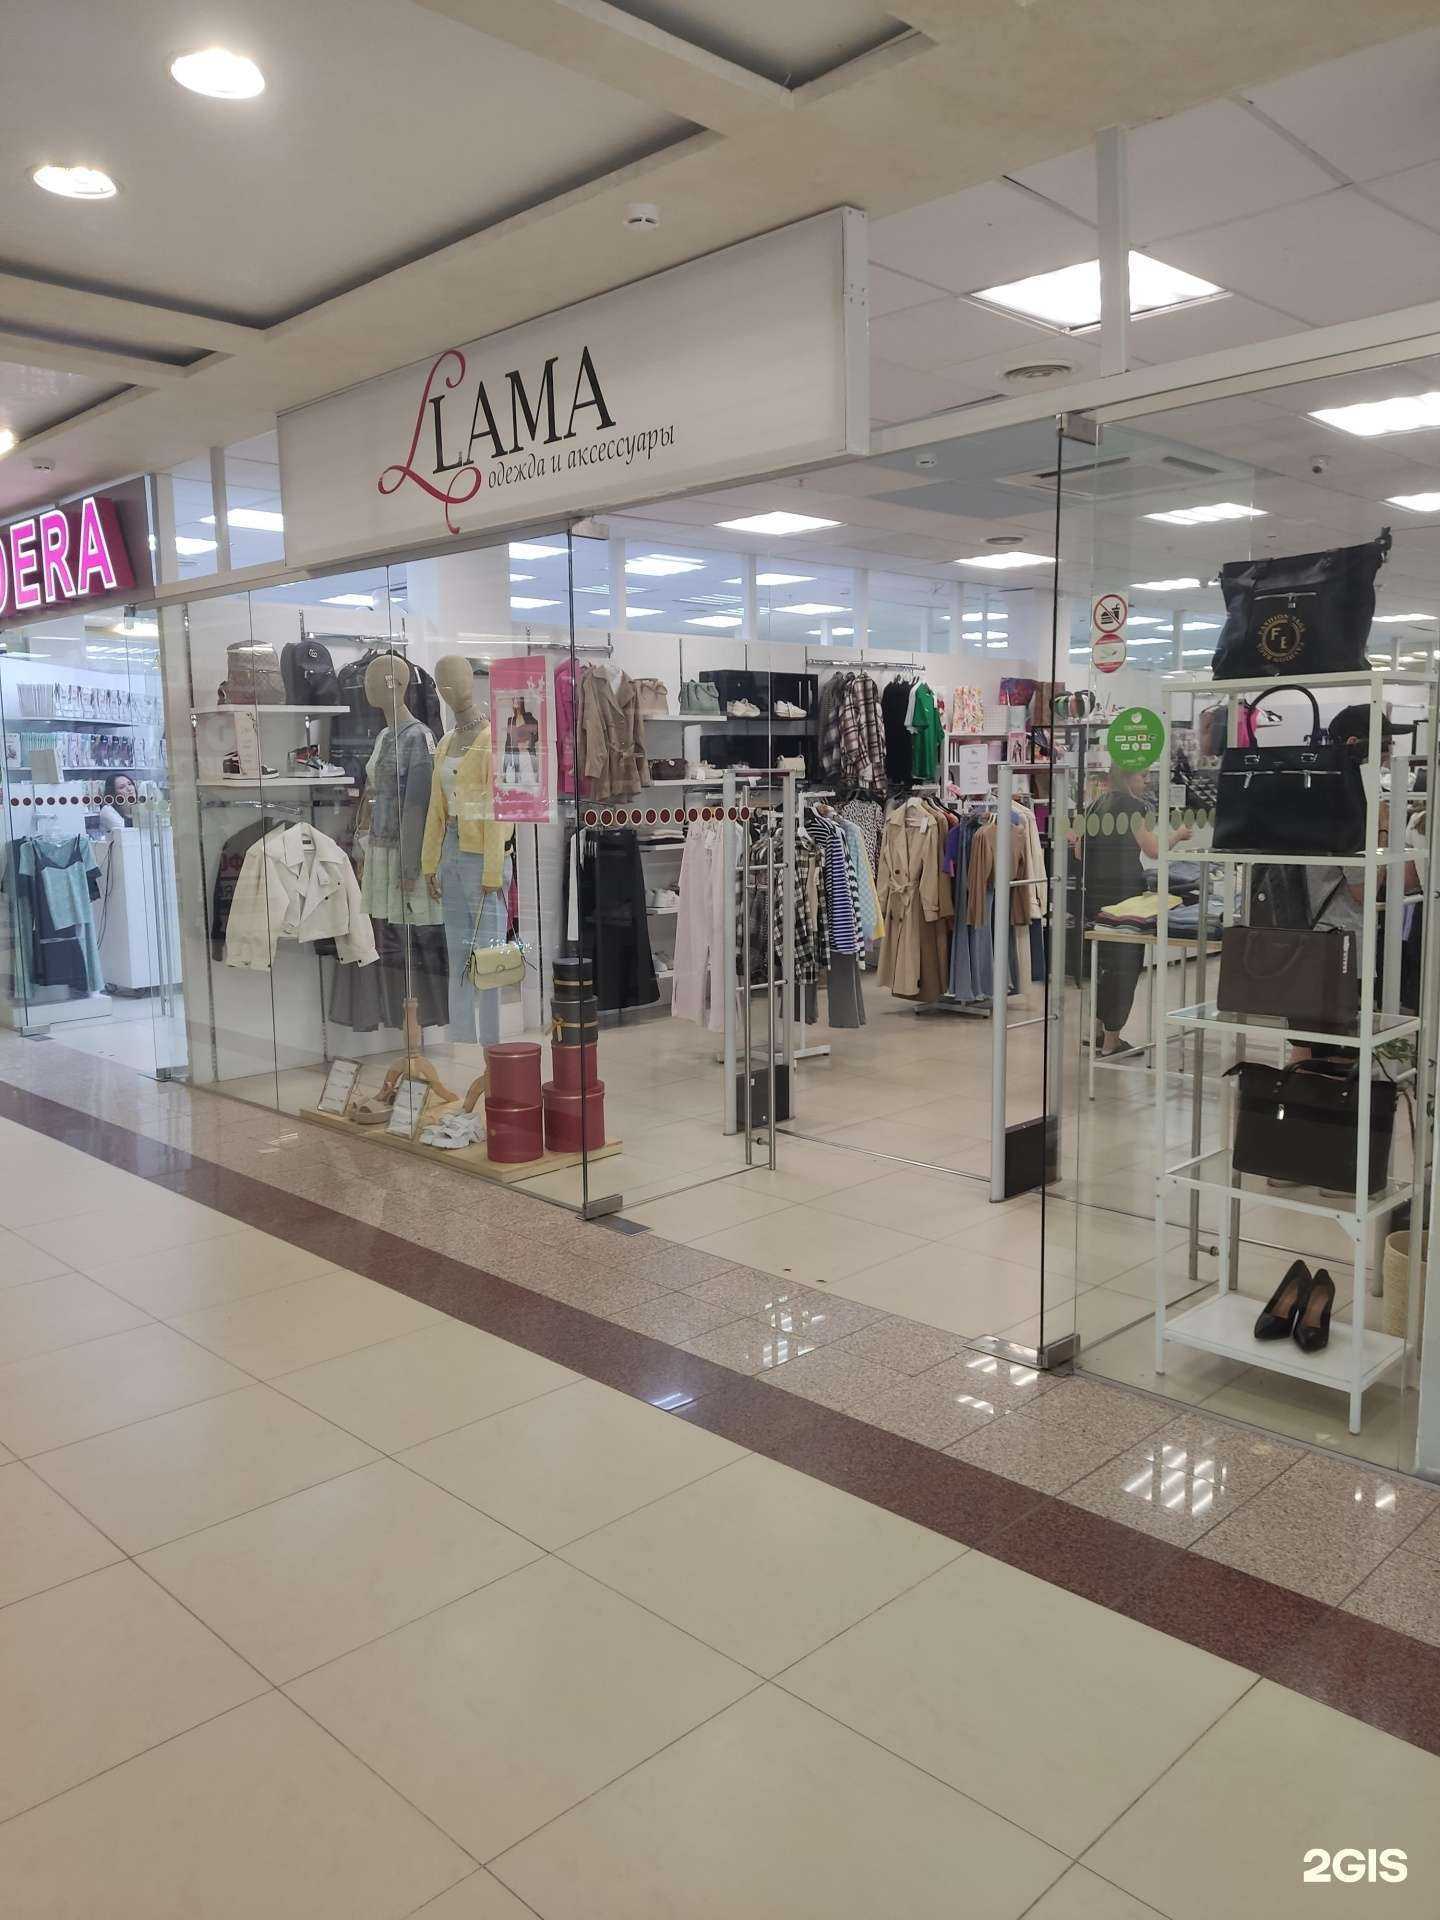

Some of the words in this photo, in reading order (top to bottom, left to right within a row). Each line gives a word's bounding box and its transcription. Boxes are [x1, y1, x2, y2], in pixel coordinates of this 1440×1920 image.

[487, 452, 546, 489] одежда
[550, 455, 562, 473] и
[567, 424, 676, 468] аксессуары
